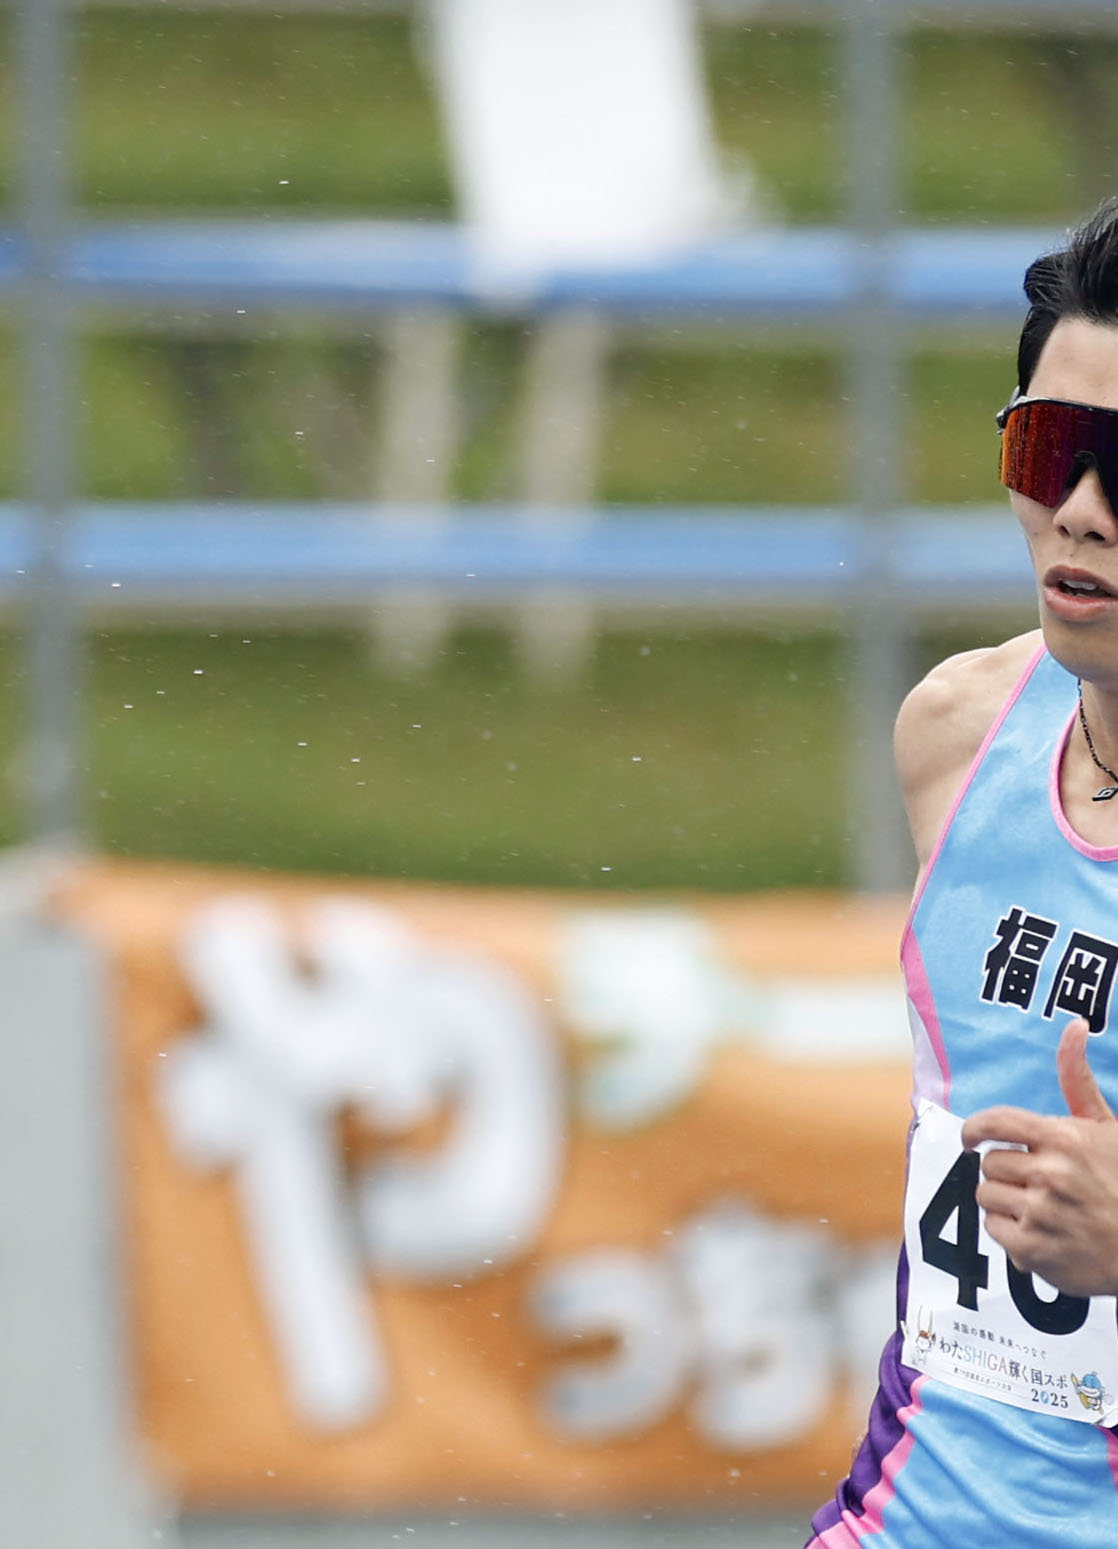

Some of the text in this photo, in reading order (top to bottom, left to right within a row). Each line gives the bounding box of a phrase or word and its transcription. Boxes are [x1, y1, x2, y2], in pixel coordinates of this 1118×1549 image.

[940, 1337, 1068, 1389] わたSHIGA輝く国スポ
[1030, 1388, 1069, 1409] 2025
